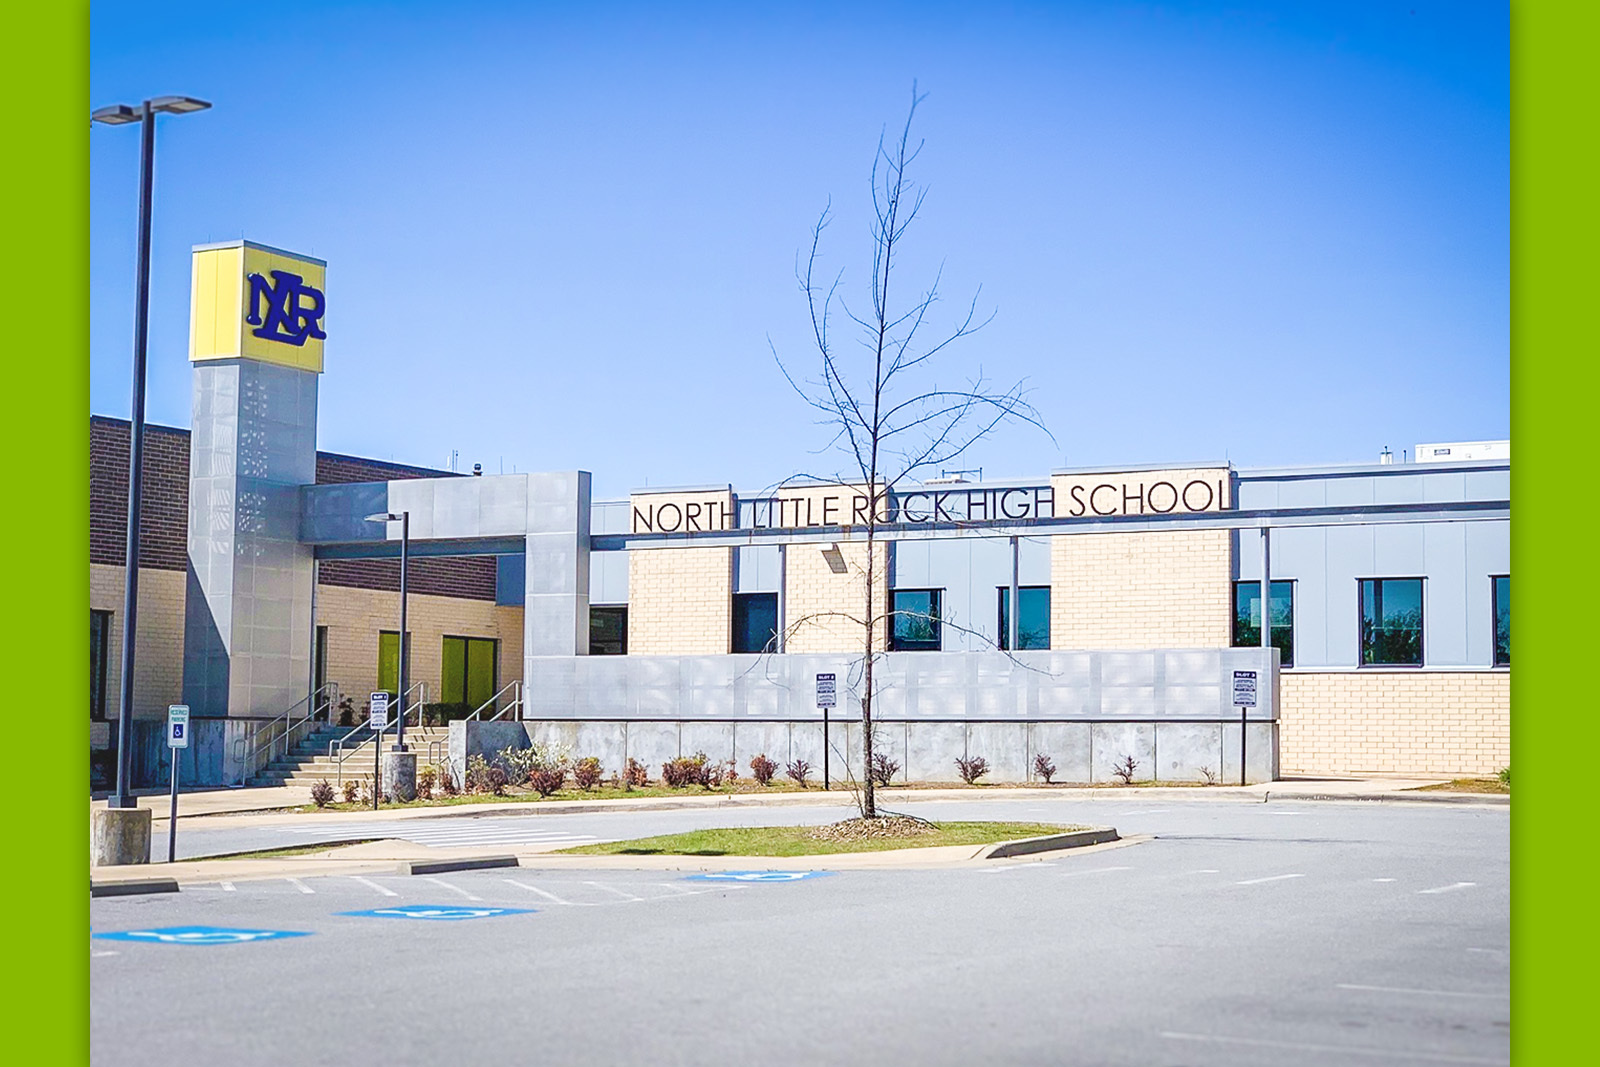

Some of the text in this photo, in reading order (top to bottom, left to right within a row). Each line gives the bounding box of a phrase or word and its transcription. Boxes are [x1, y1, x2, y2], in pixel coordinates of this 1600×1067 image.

[633, 479, 1234, 533] NORTH LITTLE ROCK HIGH SCHOOL
